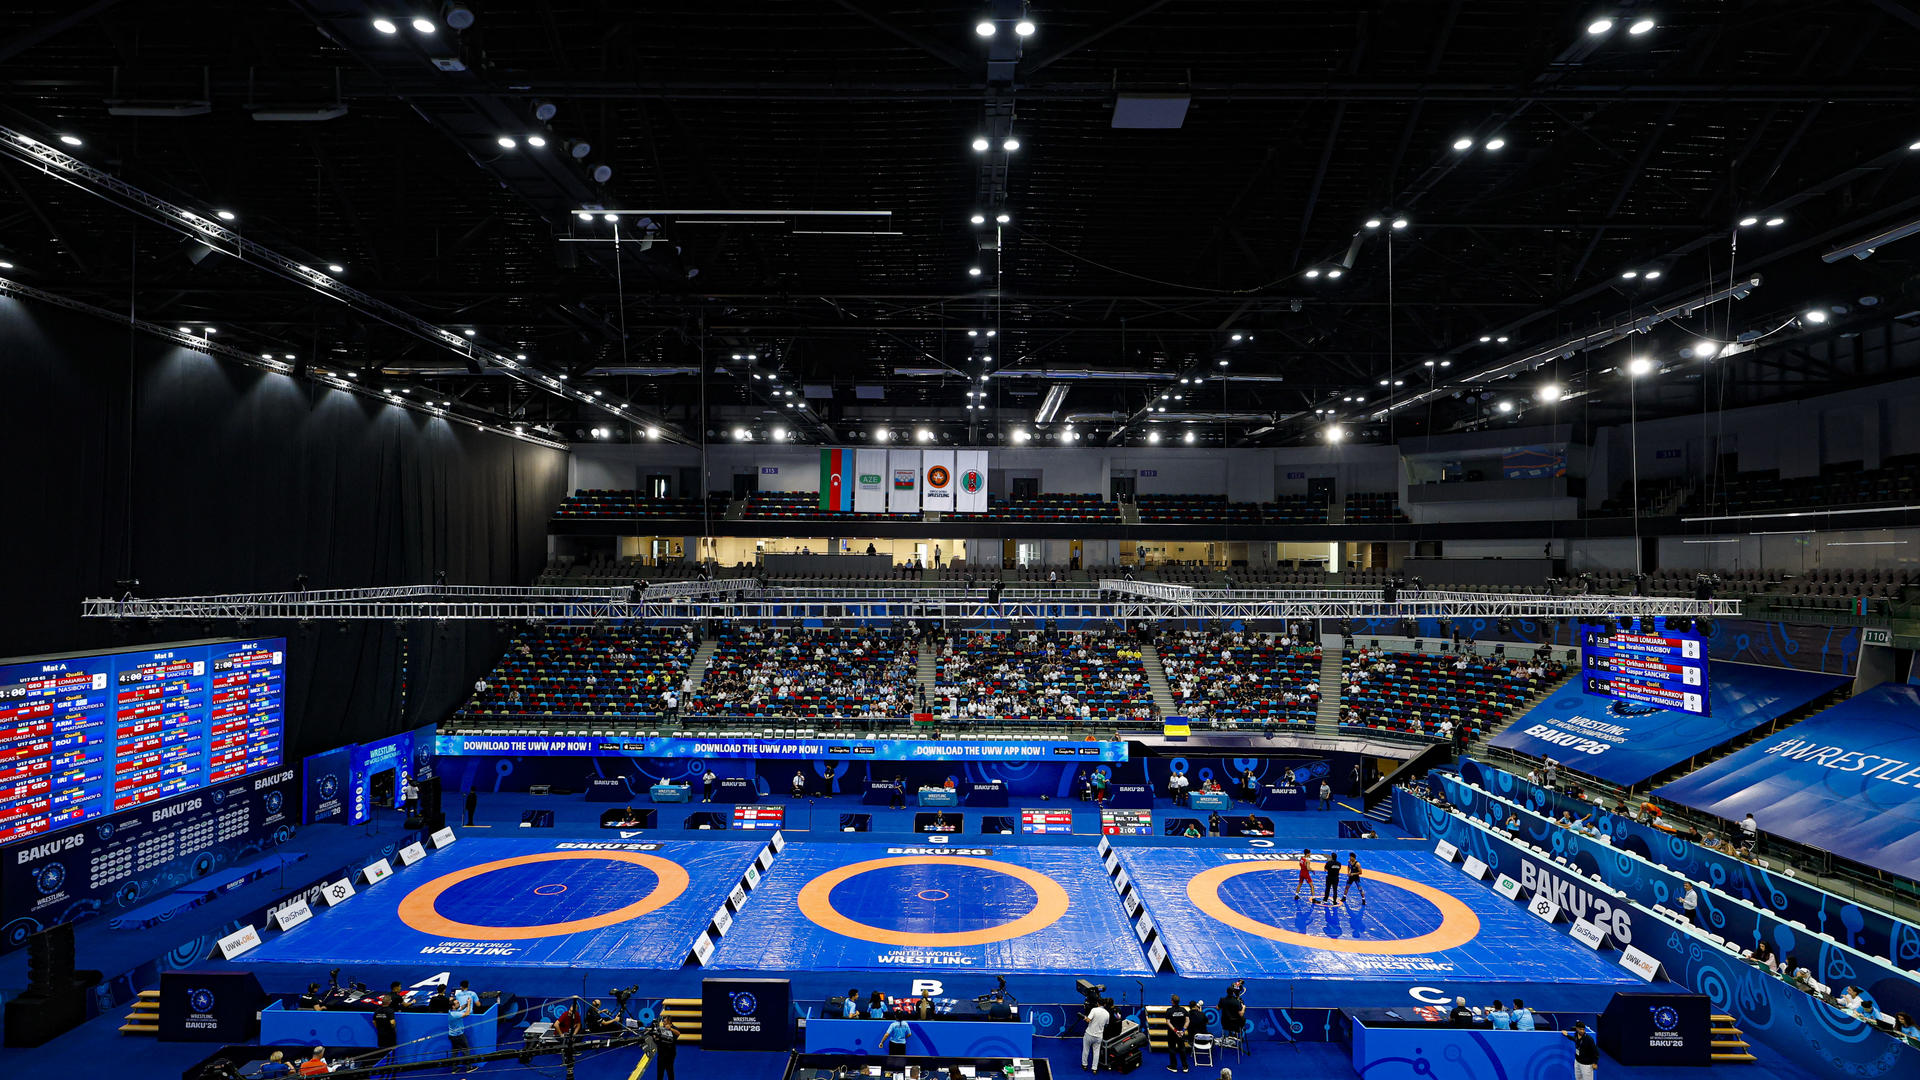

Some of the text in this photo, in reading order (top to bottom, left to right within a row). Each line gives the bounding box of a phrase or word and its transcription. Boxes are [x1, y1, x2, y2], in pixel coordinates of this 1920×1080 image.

[1588, 634, 1594, 643] A
[1640, 637, 1667, 645] LOMJARIA
[1868, 632, 1884, 641] 110
[1626, 643, 1671, 654] Ibrahim NASIBOV
[1590, 657, 1594, 665] B
[120, 673, 142, 682] 4:00
[1644, 671, 1670, 679] SANCHEZ
[1590, 680, 1594, 688] C
[0, 688, 26, 698] 4:00
[1659, 690, 1683, 698] MARKOV
[1567, 715, 1630, 735] WRESTLING
[1556, 721, 1628, 744] WORLD CHAMPIONSHIPS
[1523, 724, 1611, 754] BAKU'26
[370, 744, 397, 758] WRESTLING
[464, 741, 591, 750] DOWNLOAD THE UWW APP NOW !
[695, 743, 823, 754] DOWNLOAD THE UWW APP NOW !
[917, 746, 1045, 756] DOWNLOAD THE UWW APP NOW !
[1764, 738, 1920, 788] #WRESTLE
[254, 770, 294, 790] BAKU'26
[152, 798, 202, 822] BAKU'26
[54, 814, 68, 822] TUR
[31, 820, 46, 829] PUR
[18, 833, 84, 864] BAKU'26
[1248, 839, 1275, 848] C
[37, 891, 65, 905] WRESTLING
[1522, 859, 1632, 944] BAKU'26
[280, 907, 308, 924] TaiShan
[1574, 923, 1600, 943] TaiShan
[225, 933, 255, 951] UWW.ORG
[420, 946, 522, 956] WRESTLING
[878, 955, 976, 964] WRESTLING
[1626, 953, 1653, 973] UWW.ORG
[1353, 961, 1454, 971] WRESTLING
[409, 972, 450, 988] A
[912, 979, 944, 996] B
[1408, 986, 1452, 1004] C
